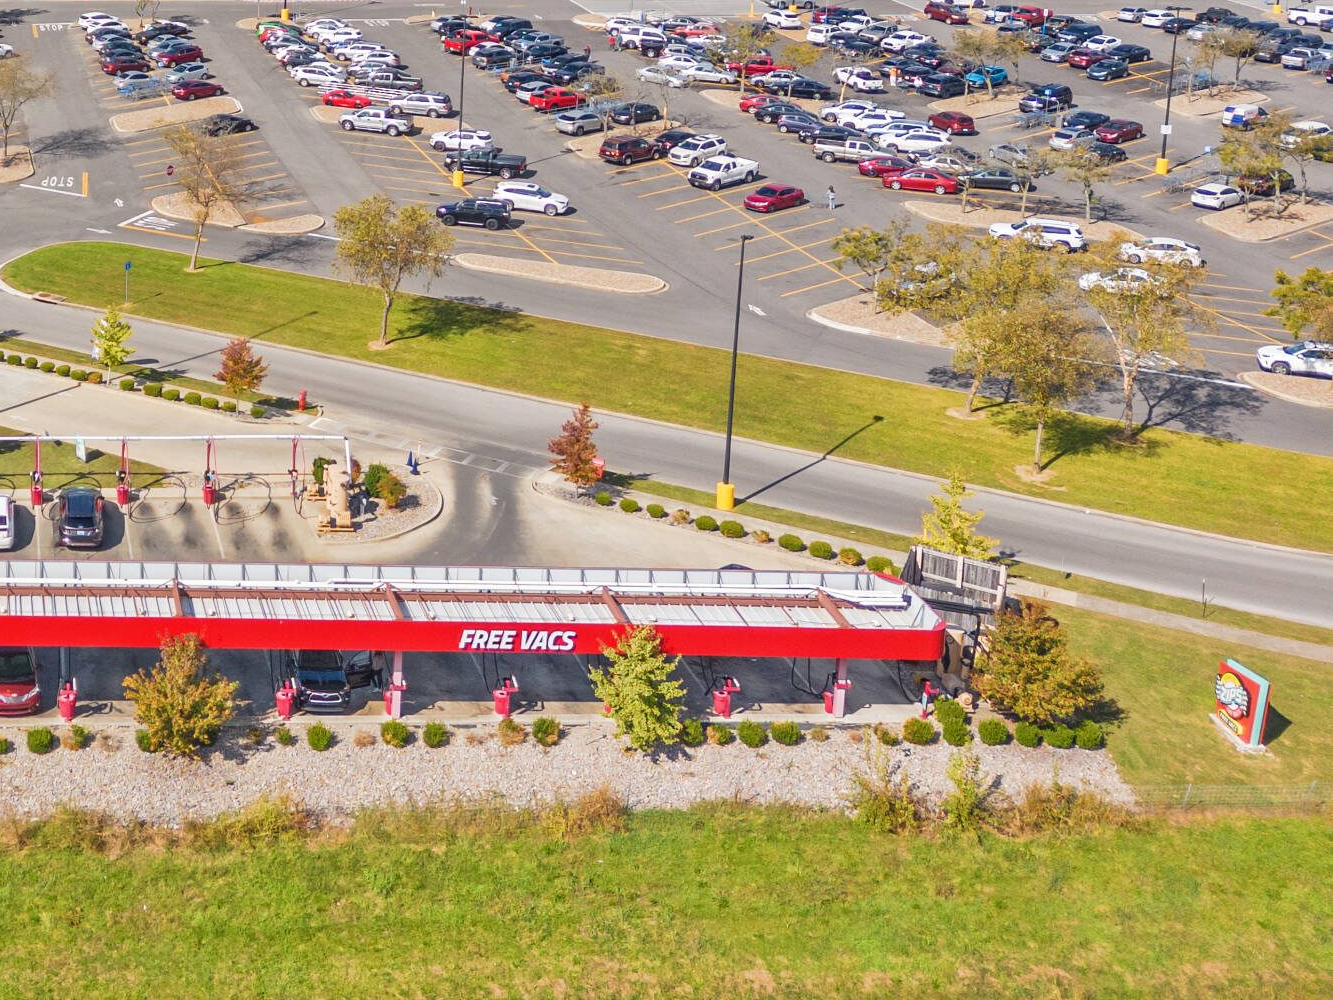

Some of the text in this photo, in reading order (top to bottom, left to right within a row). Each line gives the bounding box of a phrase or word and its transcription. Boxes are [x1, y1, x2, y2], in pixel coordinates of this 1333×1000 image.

[39, 24, 63, 32] STOP
[41, 175, 75, 188] STOP
[458, 629, 577, 651] FREE VACS
